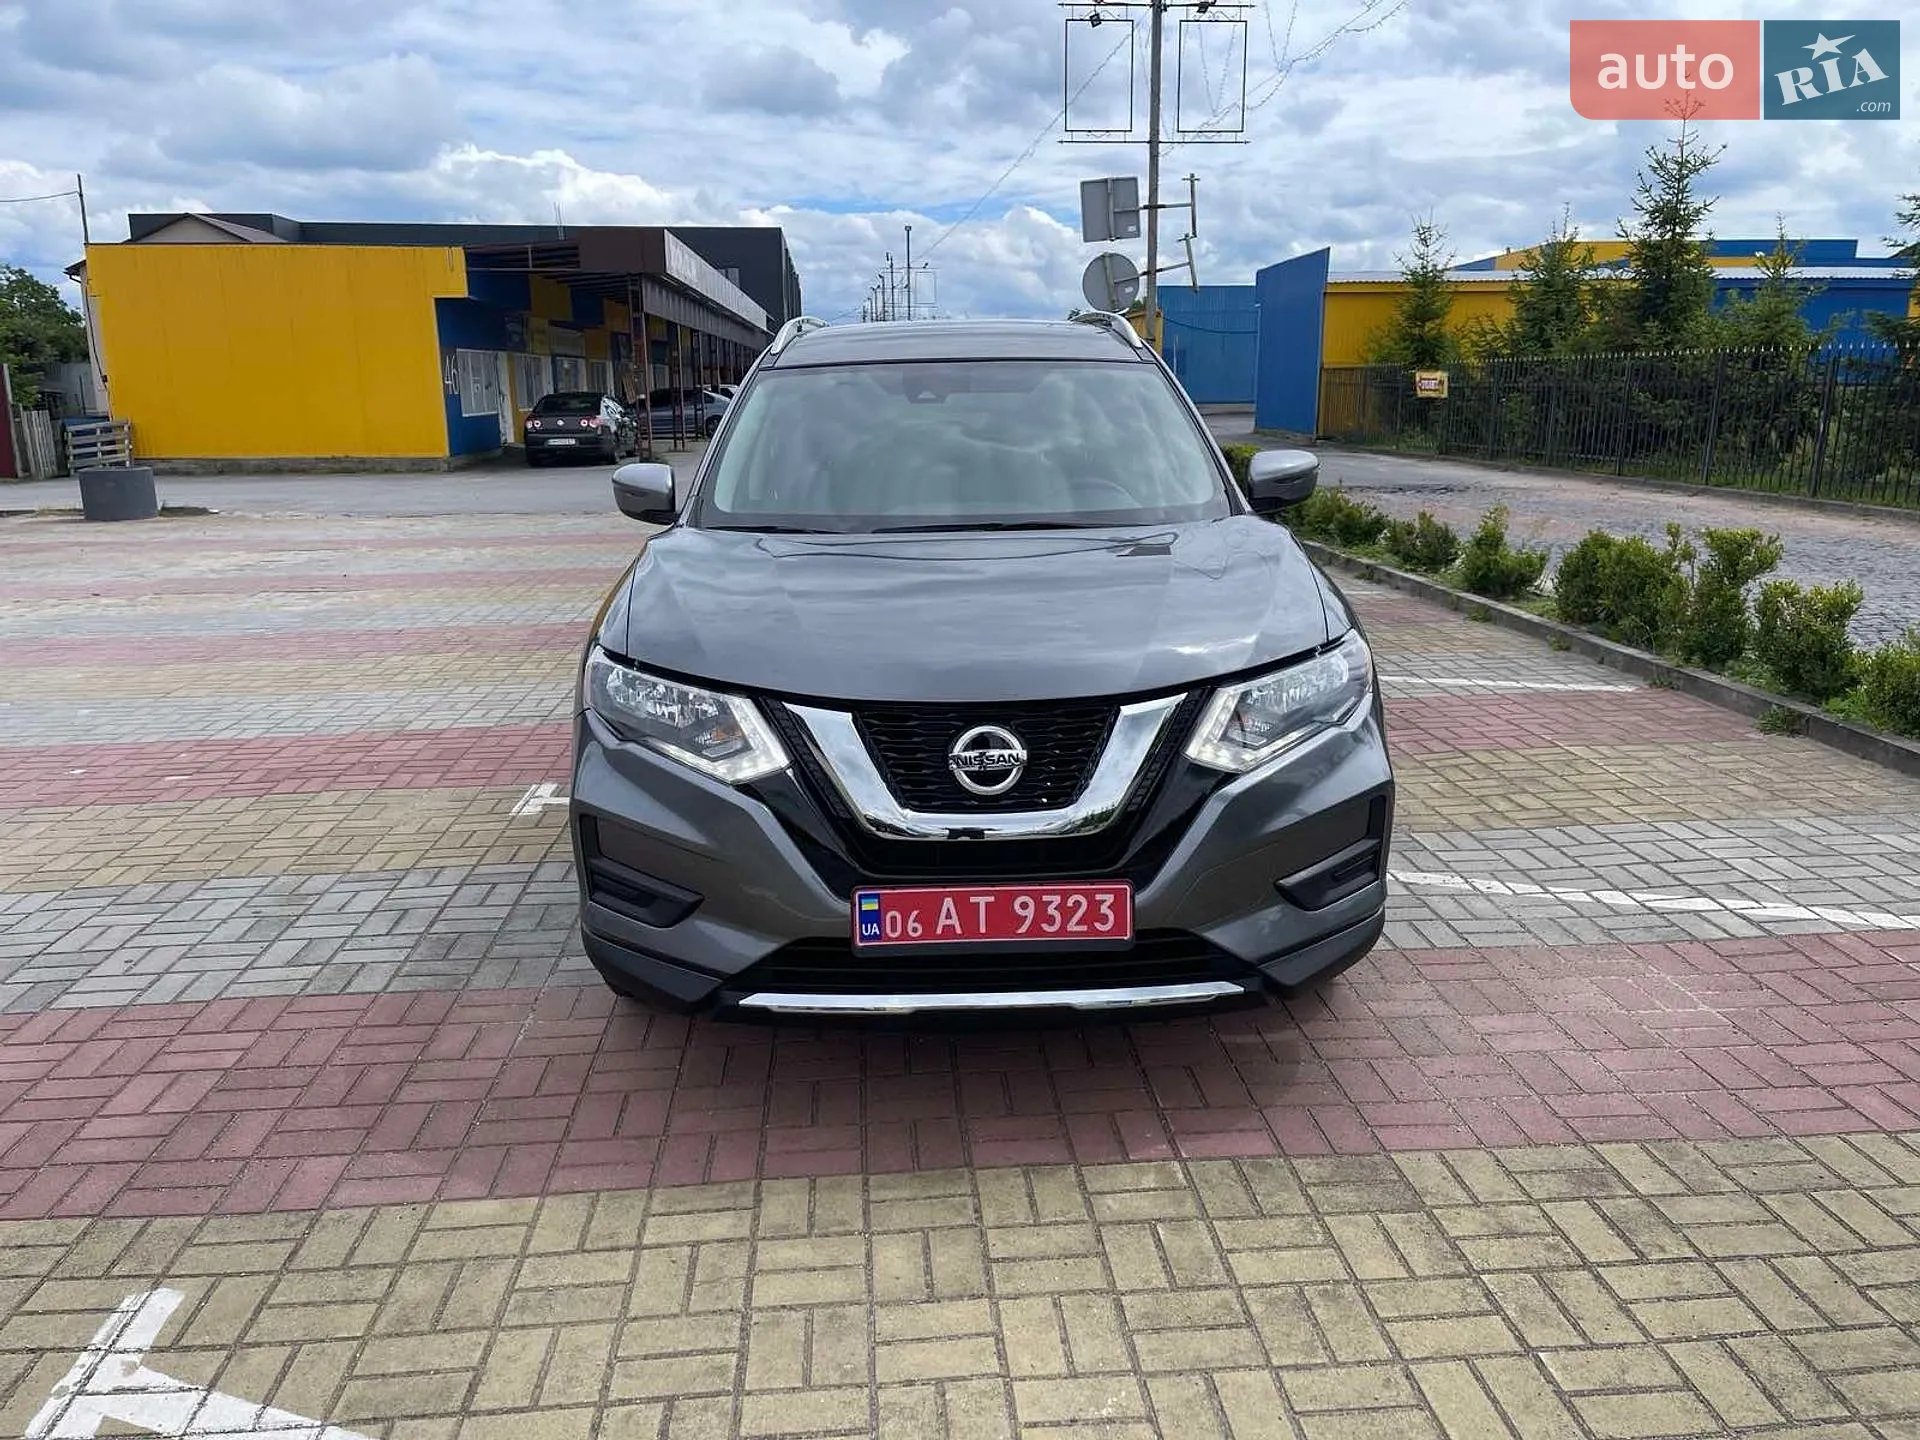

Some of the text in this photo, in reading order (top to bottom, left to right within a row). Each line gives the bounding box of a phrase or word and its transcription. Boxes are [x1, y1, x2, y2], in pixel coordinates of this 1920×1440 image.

[953, 752, 1020, 767] NISSAN
[885, 893, 1115, 938] 06 AT 9323
[861, 923, 880, 936] UA
